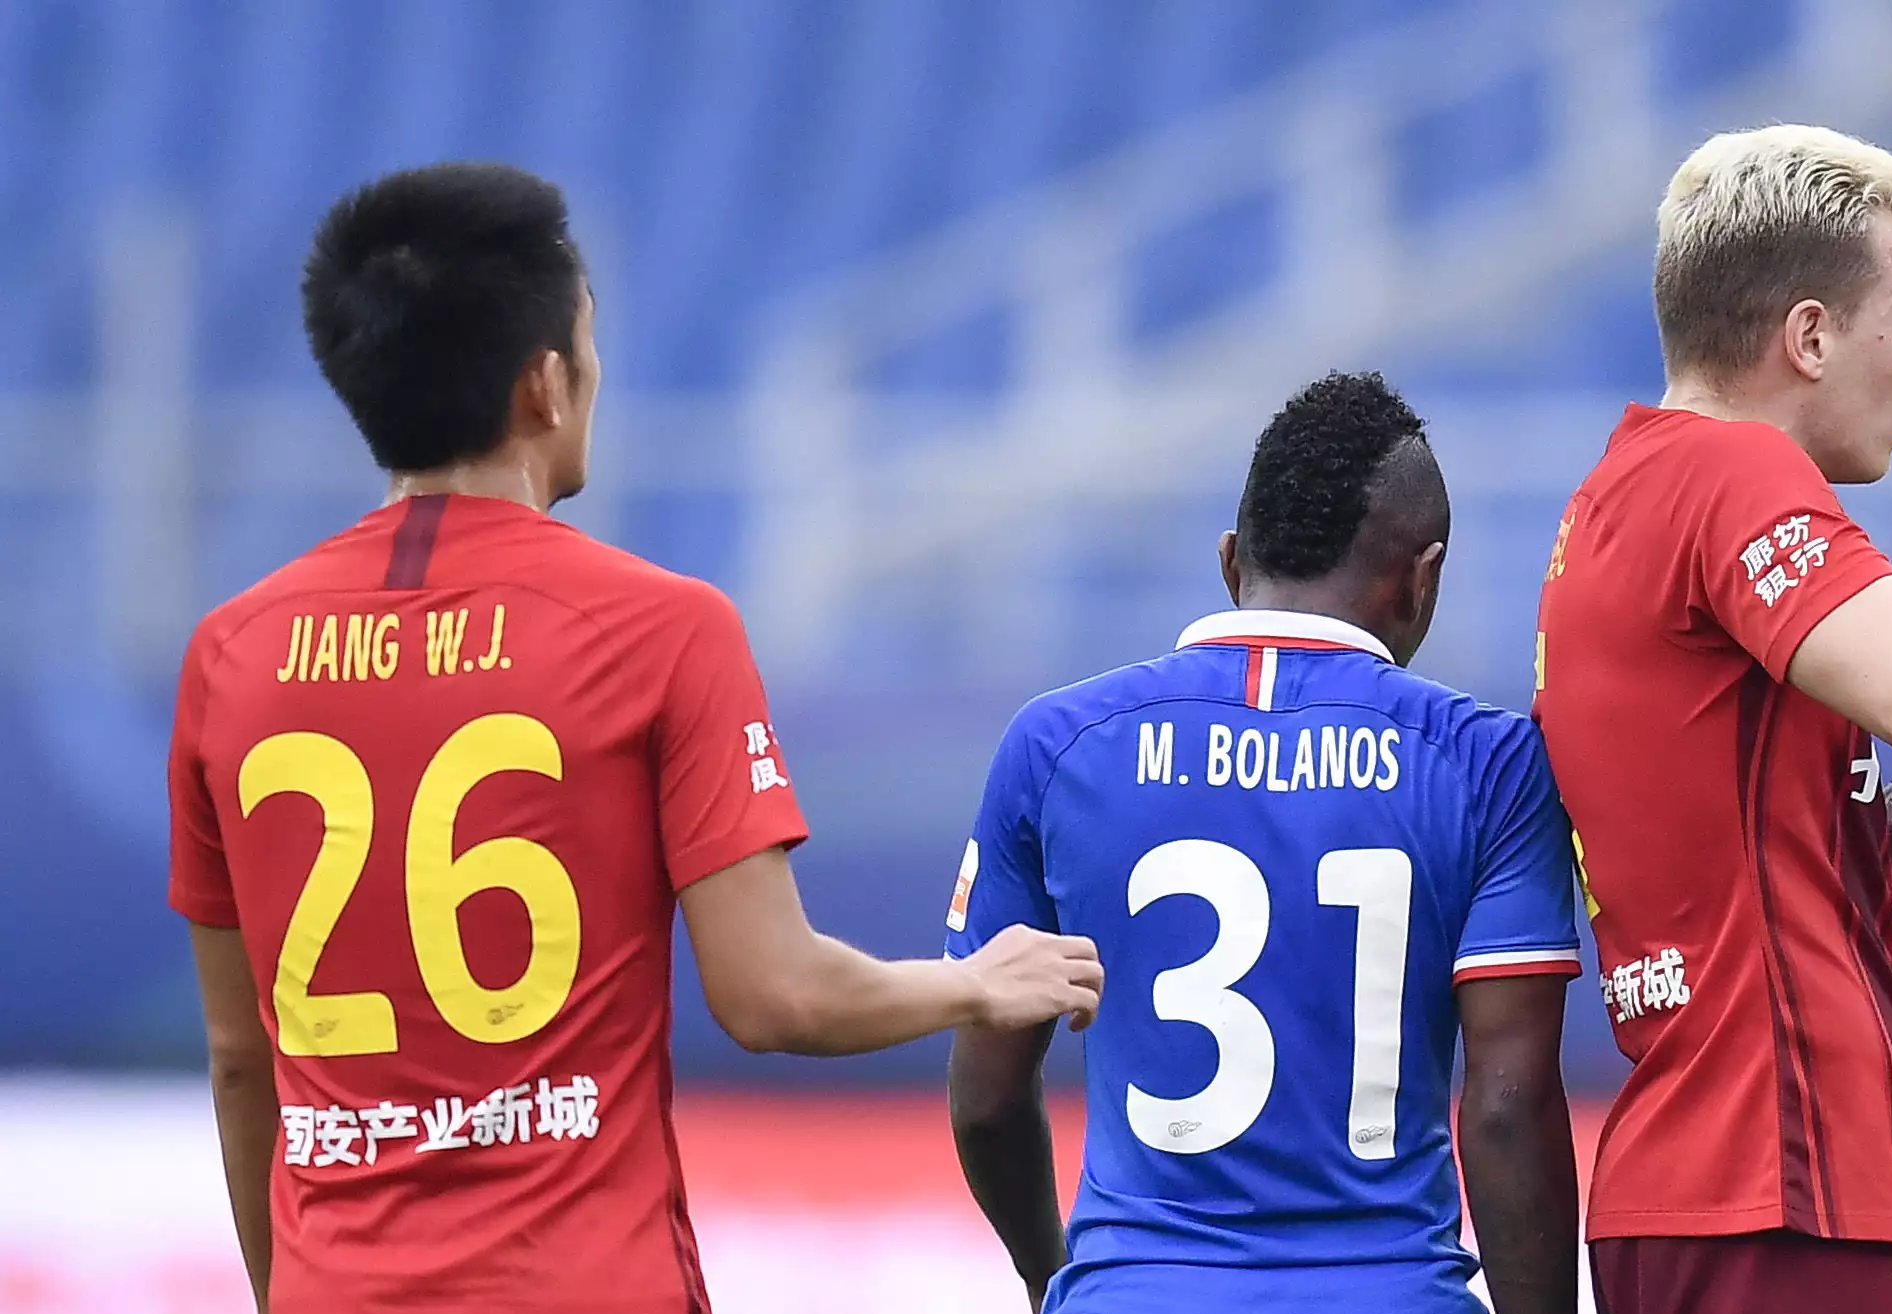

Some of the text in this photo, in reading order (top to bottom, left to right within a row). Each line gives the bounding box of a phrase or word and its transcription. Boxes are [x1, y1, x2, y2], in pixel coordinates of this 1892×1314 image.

[1739, 514, 1811, 580] 廊坊
[1754, 537, 1830, 608] 银行
[277, 604, 513, 683] JIANG W.J.
[1136, 722, 1401, 792] M. BOLANOS
[238, 712, 582, 1057] 26
[1127, 838, 1414, 1160] 31
[280, 1075, 600, 1168] 固安产业新城
